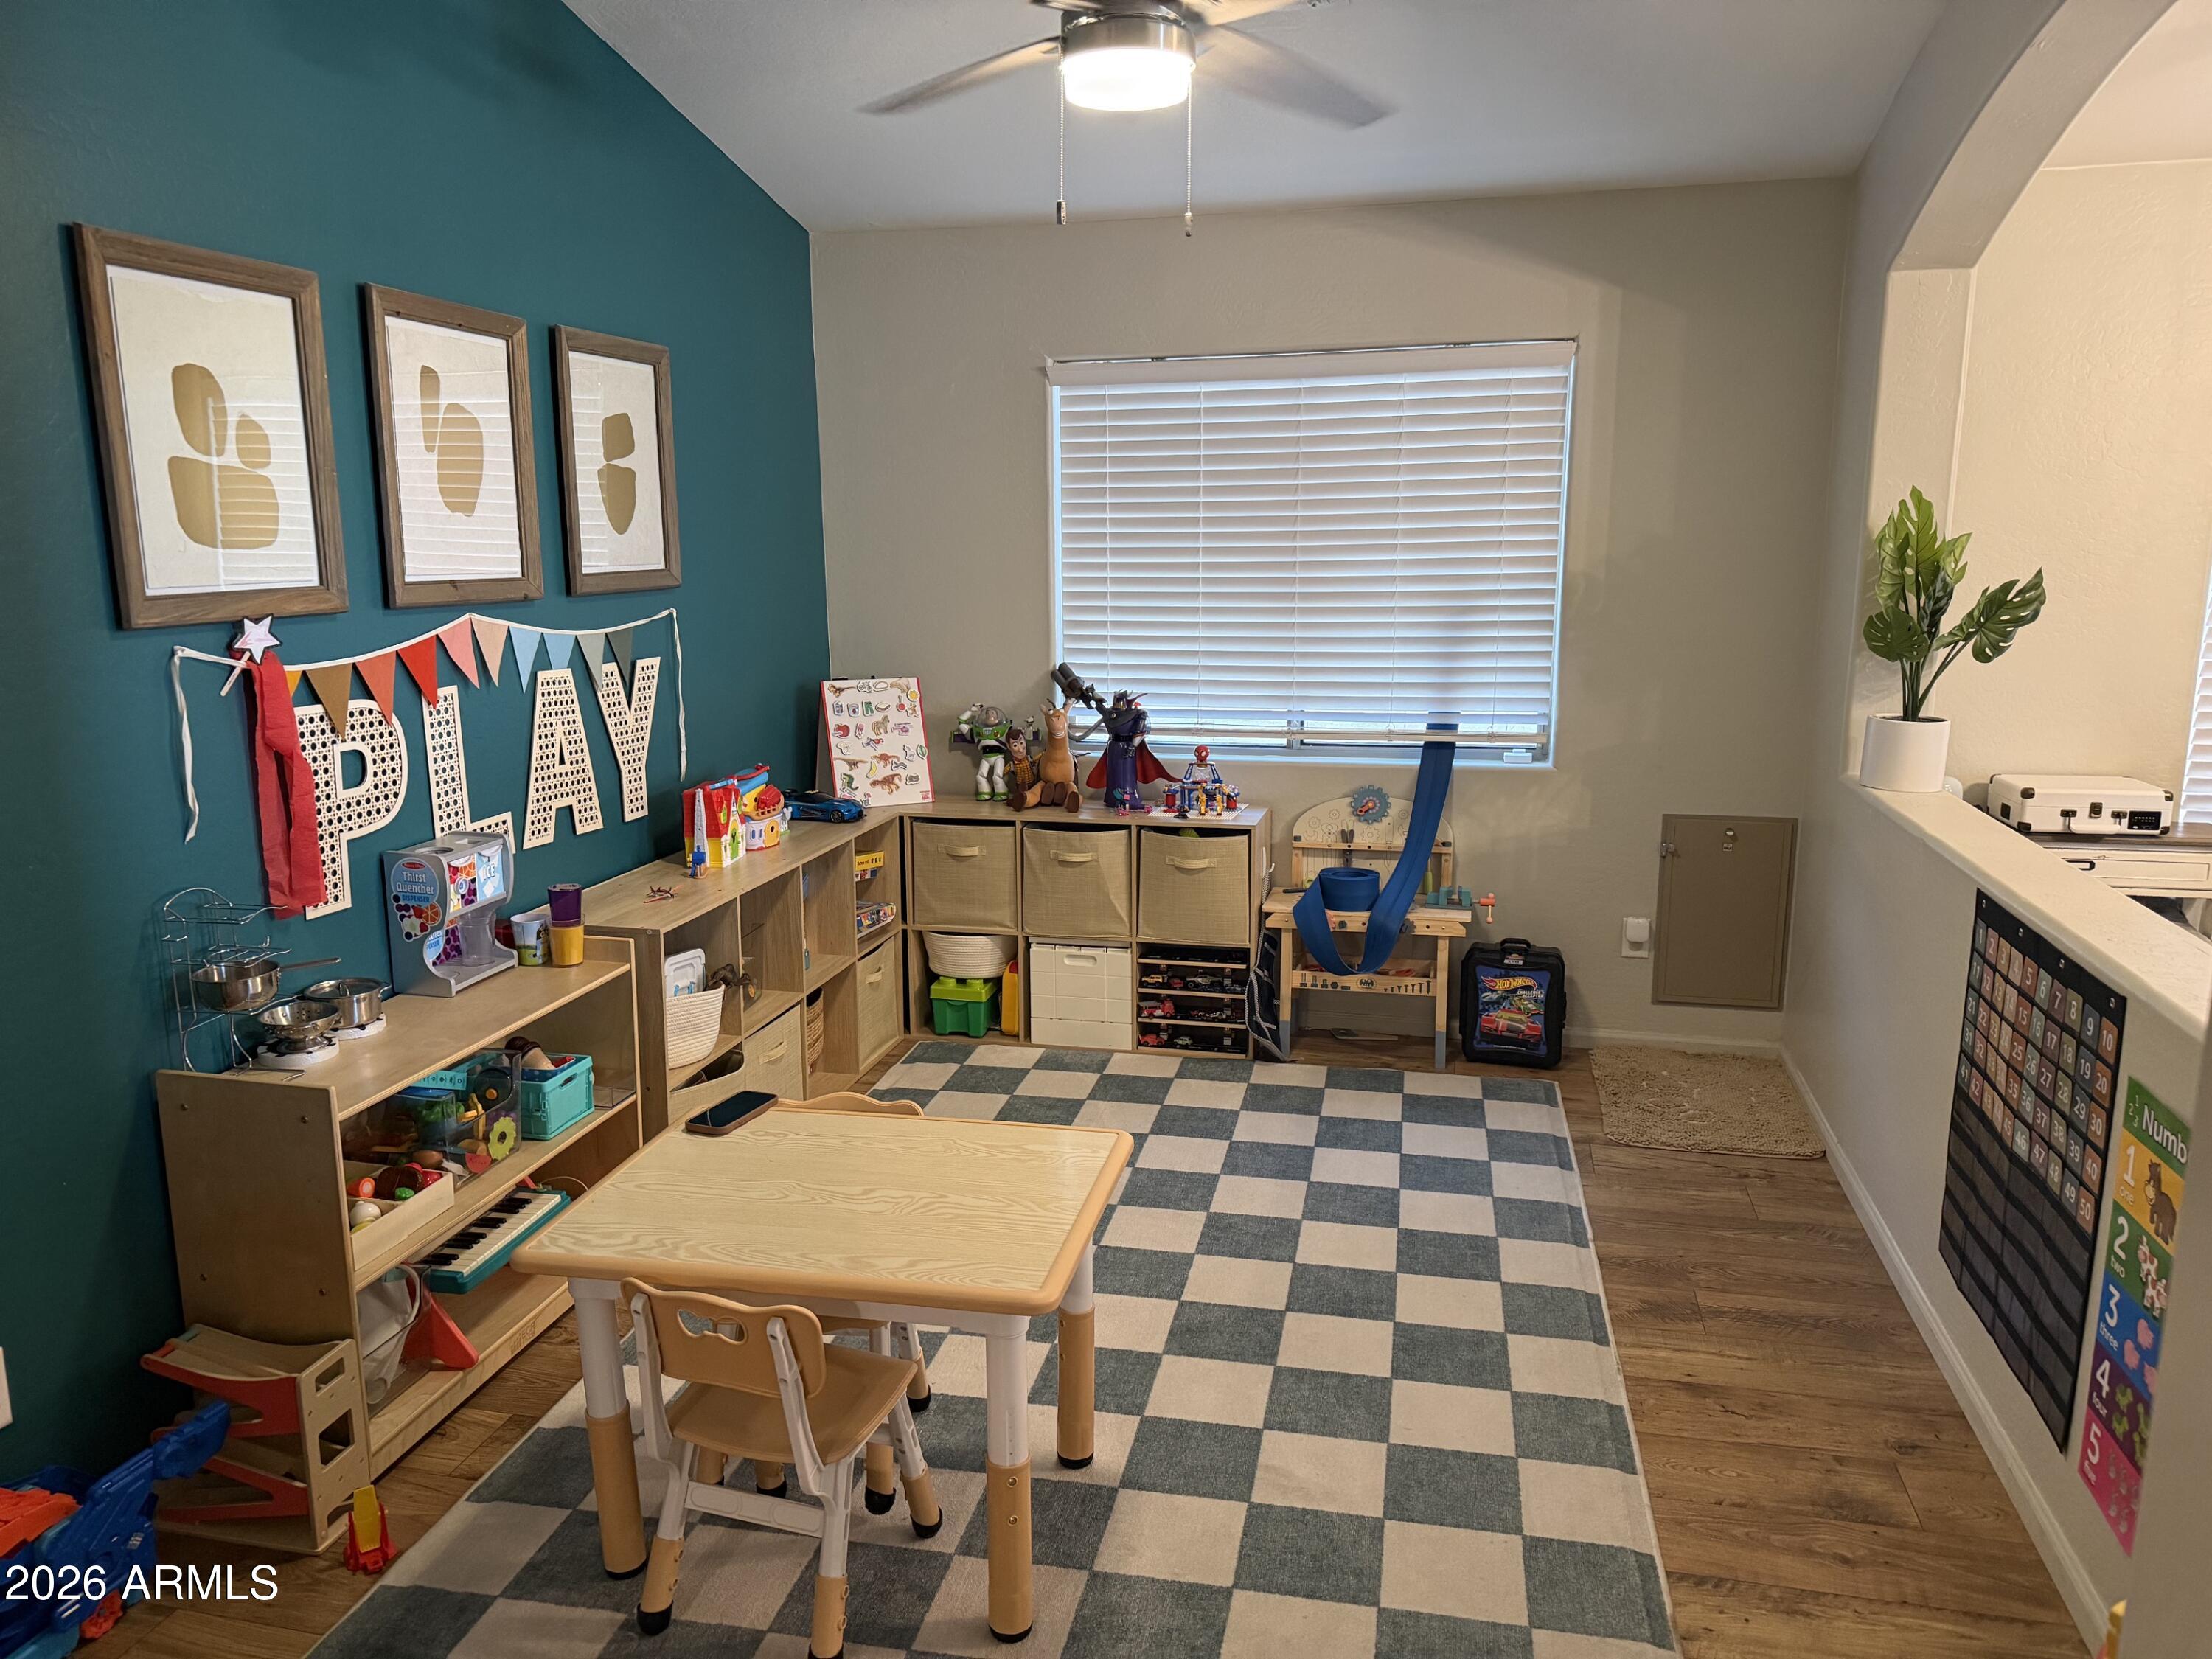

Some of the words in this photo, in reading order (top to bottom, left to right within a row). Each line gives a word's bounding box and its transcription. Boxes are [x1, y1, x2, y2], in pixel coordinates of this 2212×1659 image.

[293, 657, 661, 920] PLAY
[397, 882, 434, 894] Quencher
[402, 872, 426, 883] Thirst
[483, 863, 495, 880] ICE
[402, 894, 430, 902] DISPENSER
[1979, 929, 1983, 944] 1
[1989, 939, 1994, 954] 2
[2000, 949, 2006, 964] 3
[2025, 967, 2032, 985] 5
[2040, 981, 2046, 998] 6
[2054, 991, 2061, 1009] 7
[2070, 1001, 2077, 1020] 8
[2087, 1017, 2094, 1036] 9
[2102, 1030, 2113, 1051] 10
[1973, 961, 1980, 979] 11
[1983, 973, 1990, 991] 12
[2019, 1007, 2027, 1025] 15
[2032, 1018, 2041, 1037] 16
[2046, 1031, 2057, 1050] 17
[2063, 1044, 2073, 1063] 18
[2080, 1059, 2091, 1079] 19
[2095, 1072, 2107, 1094] 20
[1968, 997, 1975, 1015] 21
[1978, 1008, 1986, 1026] 22
[2012, 1042, 2023, 1061] 25
[2026, 1055, 2037, 1075] 26
[2040, 1068, 2052, 1088] 27
[2057, 1082, 2068, 1103] 28
[2073, 1096, 2086, 1119] 29
[2090, 1113, 2101, 1135] 30
[1964, 1028, 1972, 1046] 31
[1975, 1040, 1984, 1059] 32
[2008, 1078, 2018, 1099] 35
[2020, 1091, 2031, 1112] 36
[2036, 1107, 2048, 1128] 37
[2053, 1120, 2064, 1142] 38
[2069, 1140, 2080, 1162] 39
[2086, 1158, 2098, 1180] 40
[2129, 1103, 2134, 1116] 2
[1971, 1077, 1980, 1096] 42
[2004, 1118, 2011, 1135] 45
[2015, 1130, 2027, 1150] 46
[2034, 1144, 2045, 1164] 47
[2049, 1162, 2059, 1182] 48
[2065, 1182, 2076, 1203] 49
[2079, 1197, 2091, 1220] 50
[2124, 1144, 2135, 1188] 1
[2119, 1186, 2135, 1206] one
[2114, 1215, 2129, 1261] 2
[2110, 1255, 2125, 1279] two
[2105, 1284, 2121, 1327] 3
[2100, 1321, 2118, 1351] three
[2096, 1359, 2110, 1399] 4
[2087, 1422, 2101, 1464] 5
